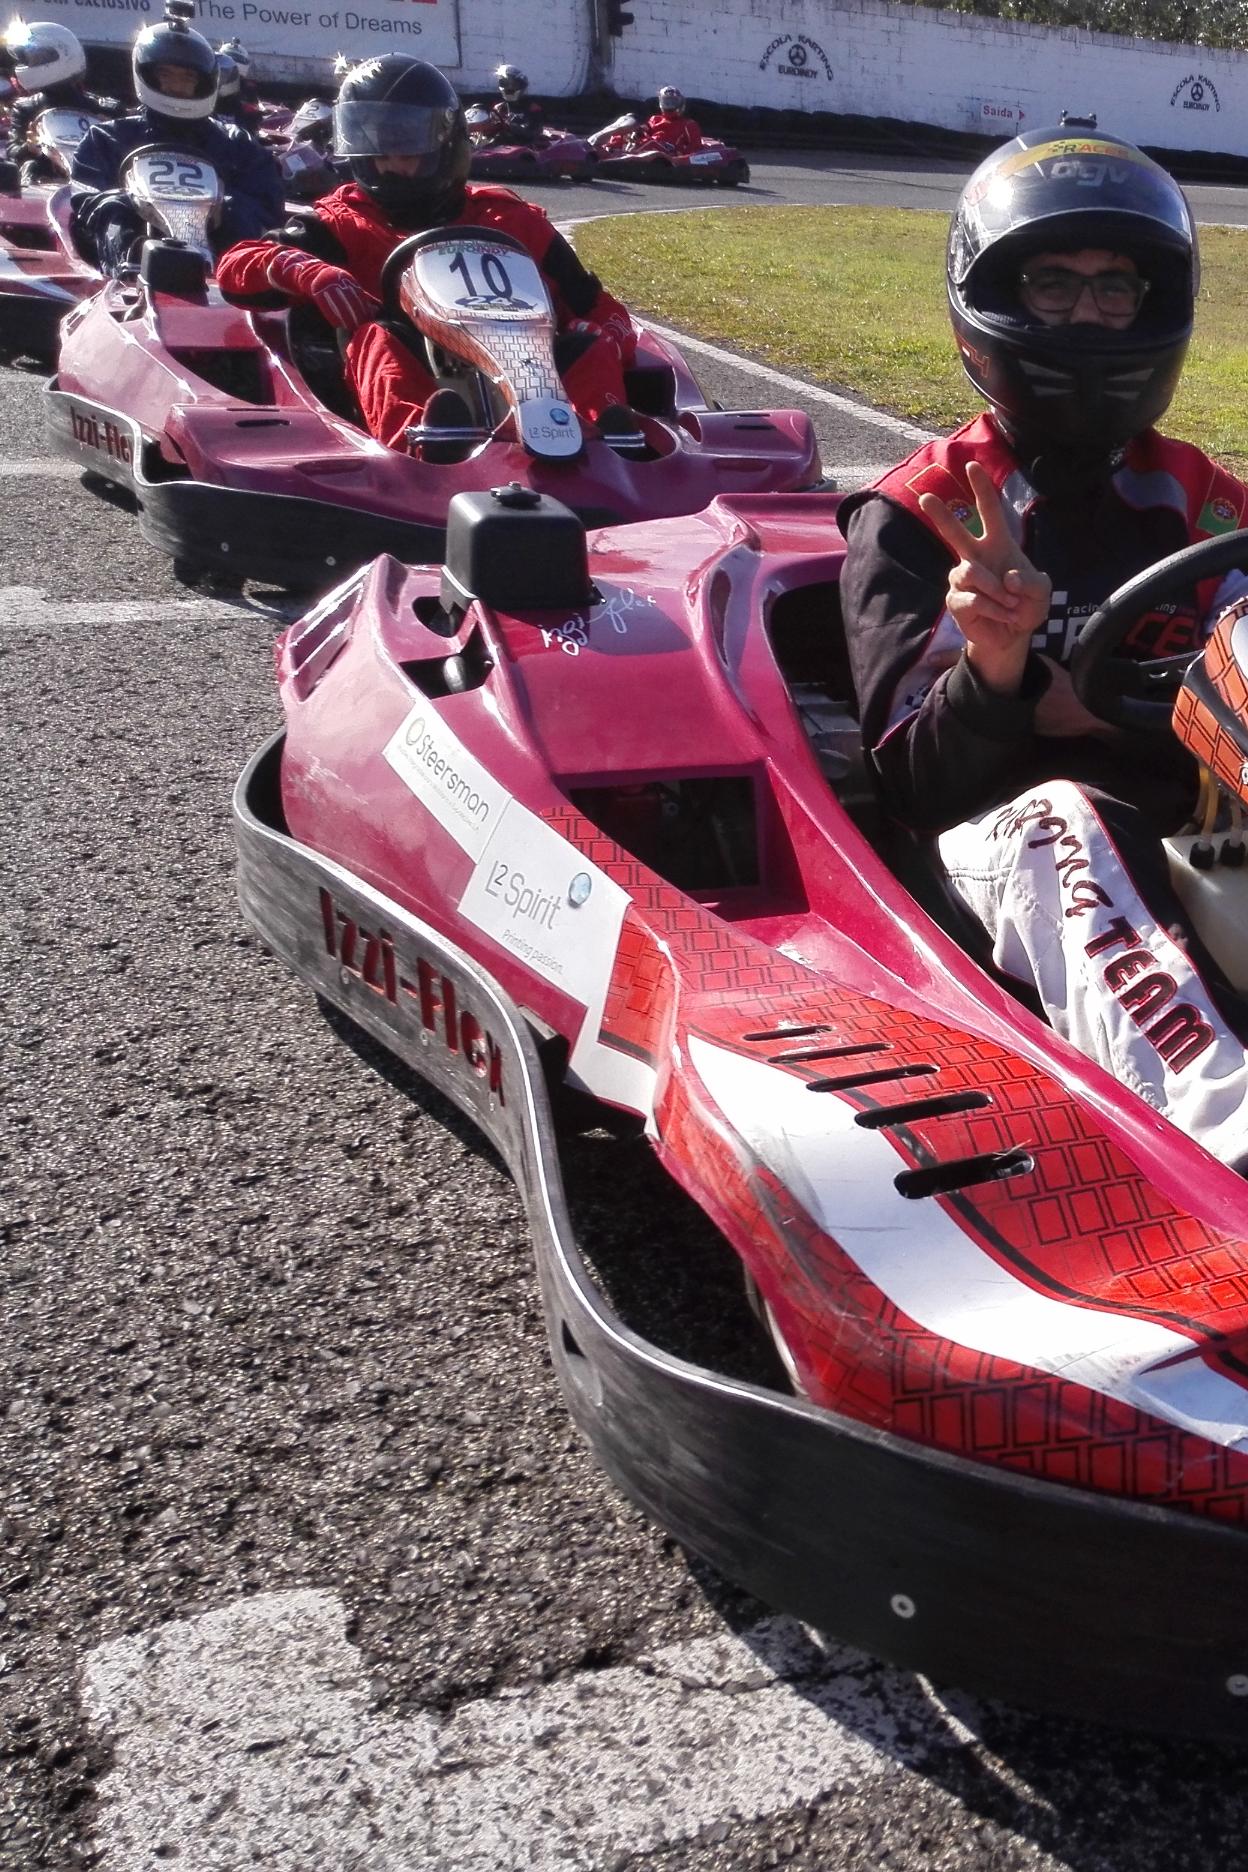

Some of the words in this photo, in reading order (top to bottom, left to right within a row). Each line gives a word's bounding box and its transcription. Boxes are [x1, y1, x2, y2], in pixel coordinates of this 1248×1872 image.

[198, 0, 234, 20] The
[243, 3, 311, 26] Power
[318, 12, 340, 28] of
[345, 12, 423, 36] Dreams
[759, 34, 792, 71] ESCOLA
[798, 34, 834, 81] KARTING
[1170, 74, 1195, 106] ESCOLA
[1198, 74, 1221, 112] KARTING
[148, 160, 205, 189] 22
[449, 252, 513, 298] 10
[70, 405, 133, 464] Izzi-Fle
[542, 425, 576, 440] Spirit
[415, 734, 490, 823] Steersman
[504, 872, 562, 931] Spirit
[501, 928, 535, 959] Printing
[319, 885, 506, 1107] Izzi-Flex
[1084, 915, 1216, 1075] TEAM
